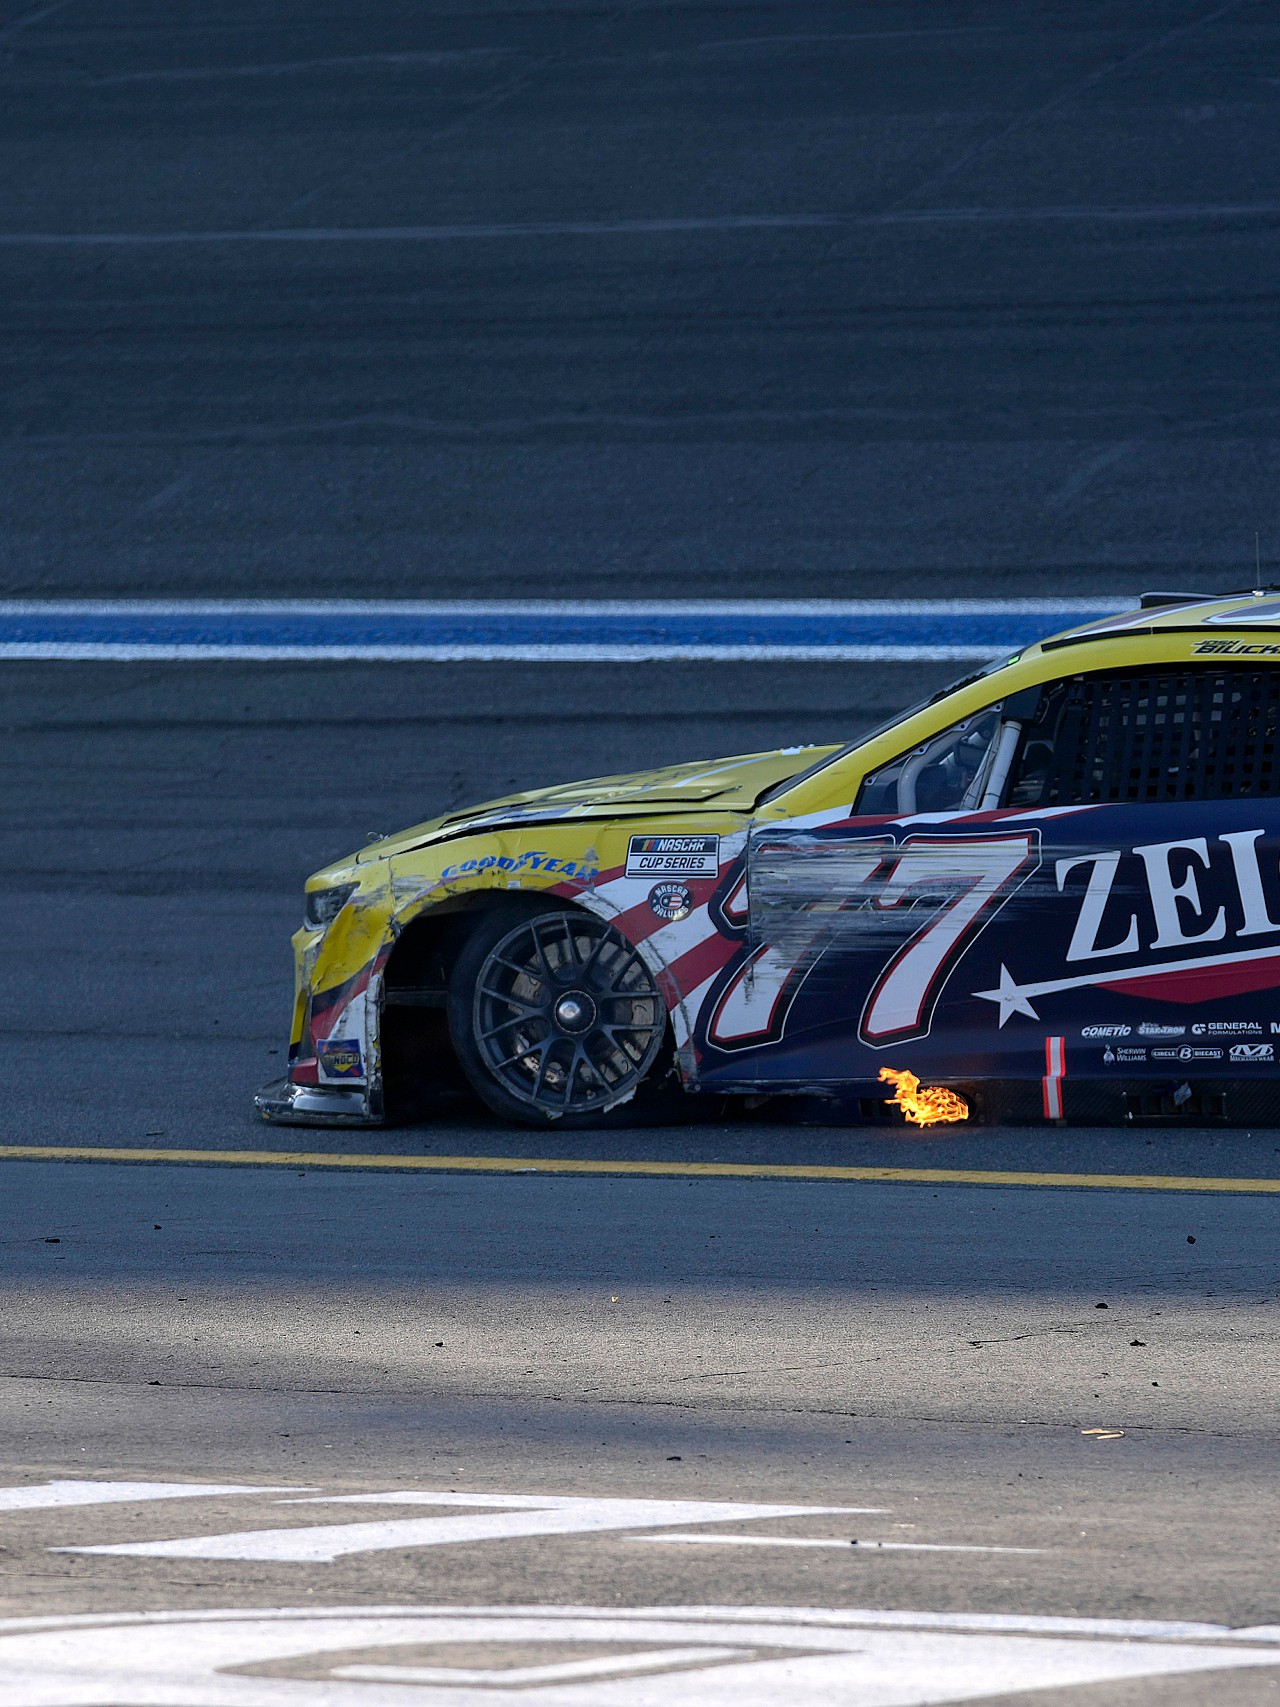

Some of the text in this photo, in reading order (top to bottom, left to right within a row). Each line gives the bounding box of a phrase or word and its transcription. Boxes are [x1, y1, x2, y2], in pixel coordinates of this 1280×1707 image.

[657, 839, 706, 851] NASCAR
[639, 857, 705, 868] CUP SERIES
[655, 884, 688, 899] NASCAR
[706, 828, 1042, 1052] 77
[1208, 1022, 1262, 1030] GENERAL
[1180, 1047, 1192, 1059] B
